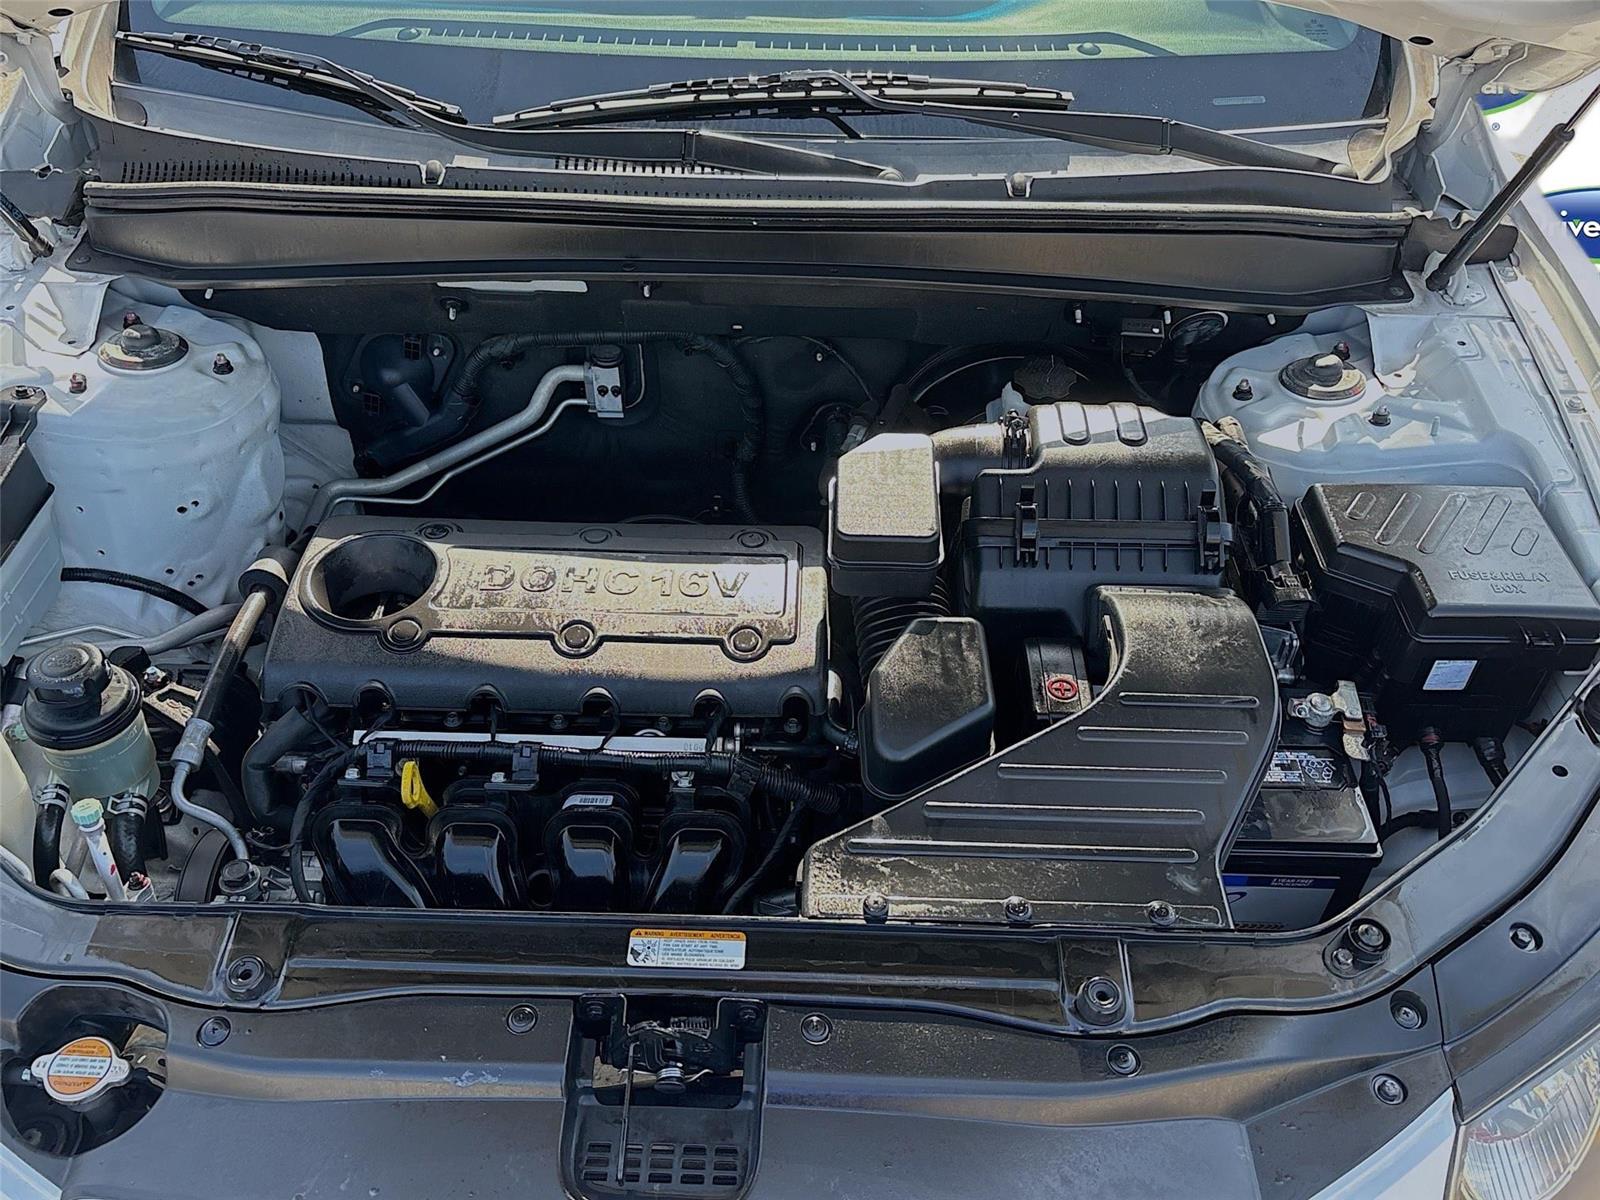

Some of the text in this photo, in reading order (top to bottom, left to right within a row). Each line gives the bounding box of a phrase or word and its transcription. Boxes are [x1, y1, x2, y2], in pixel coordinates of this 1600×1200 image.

[479, 564, 749, 598] DOHC 16V
[1447, 569, 1551, 583] FUSE&RELAY
[1490, 582, 1527, 594] BOX
